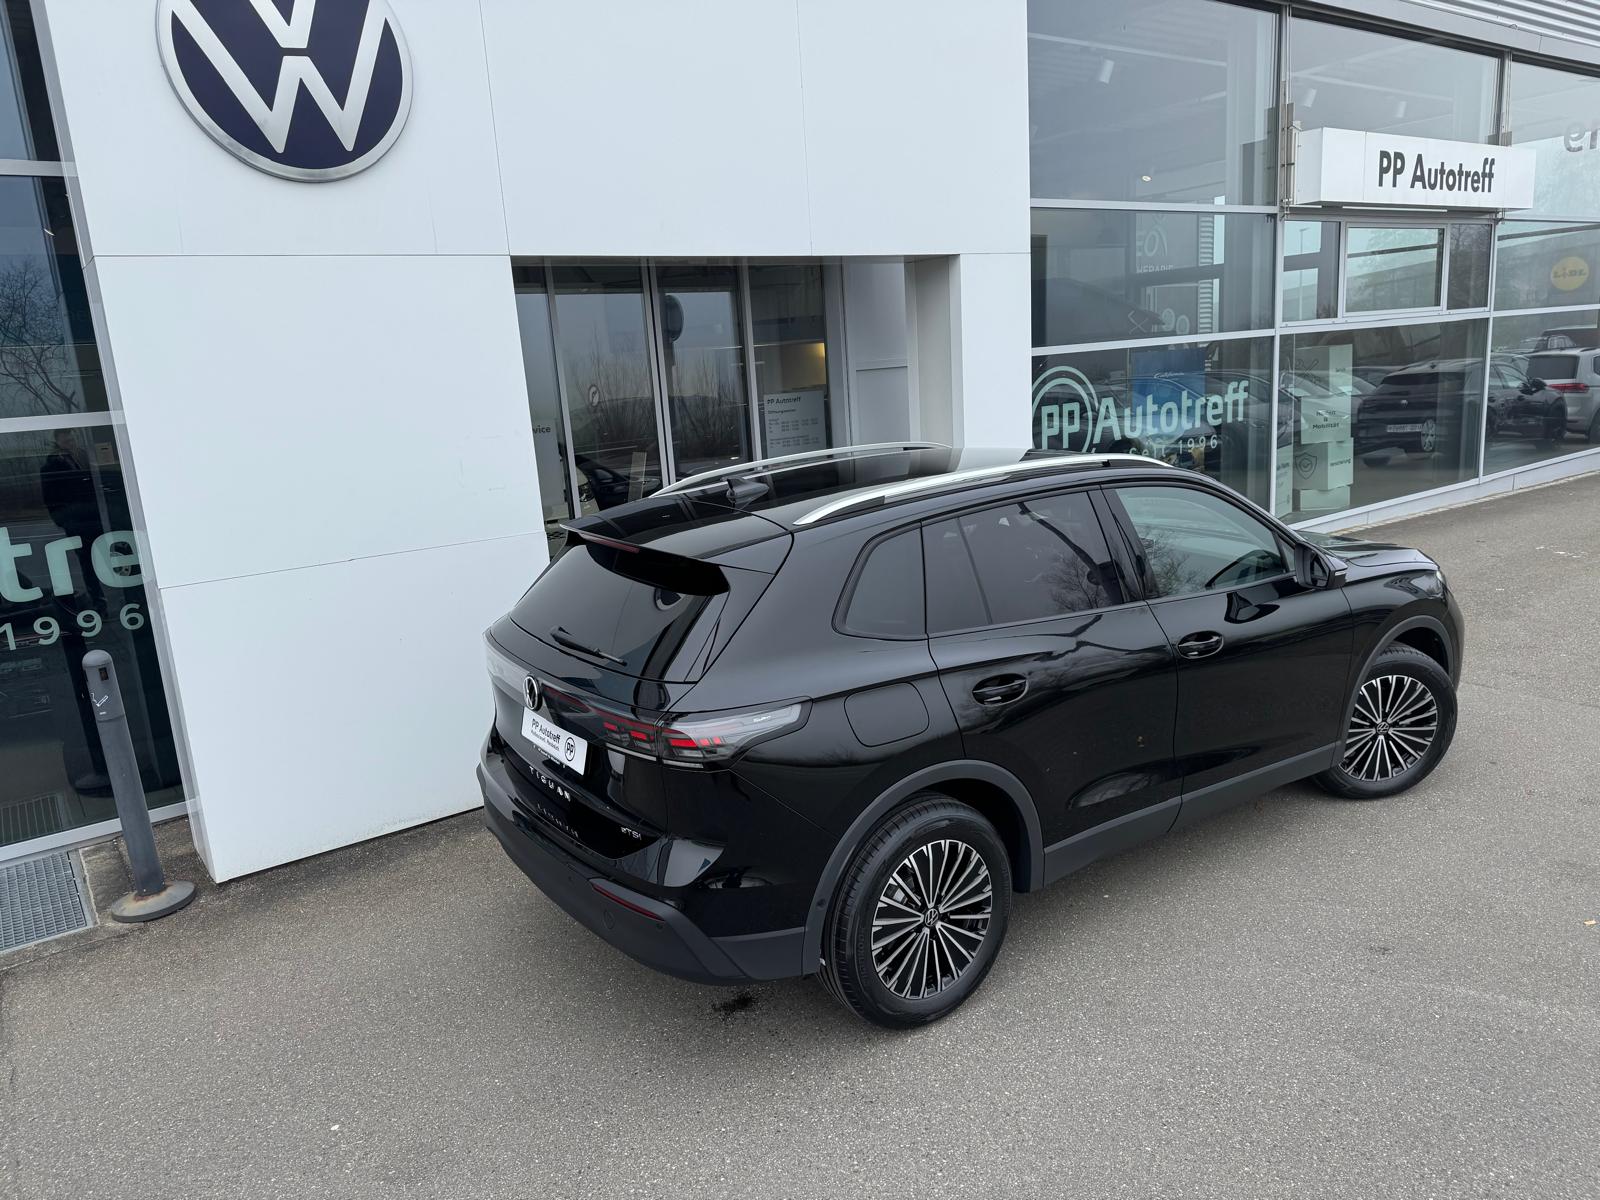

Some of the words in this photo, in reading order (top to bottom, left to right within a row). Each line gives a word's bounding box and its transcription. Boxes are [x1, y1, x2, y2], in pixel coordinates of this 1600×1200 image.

[1378, 150, 1406, 188] PP
[1409, 153, 1496, 193] Autotreff
[1041, 401, 1081, 450] PP
[1093, 380, 1249, 444] Autotreff
[1179, 434, 1218, 455] 1996
[0, 603, 145, 651] 1996
[539, 724, 561, 744] Autotreff
[529, 765, 571, 802] TIGUAN
